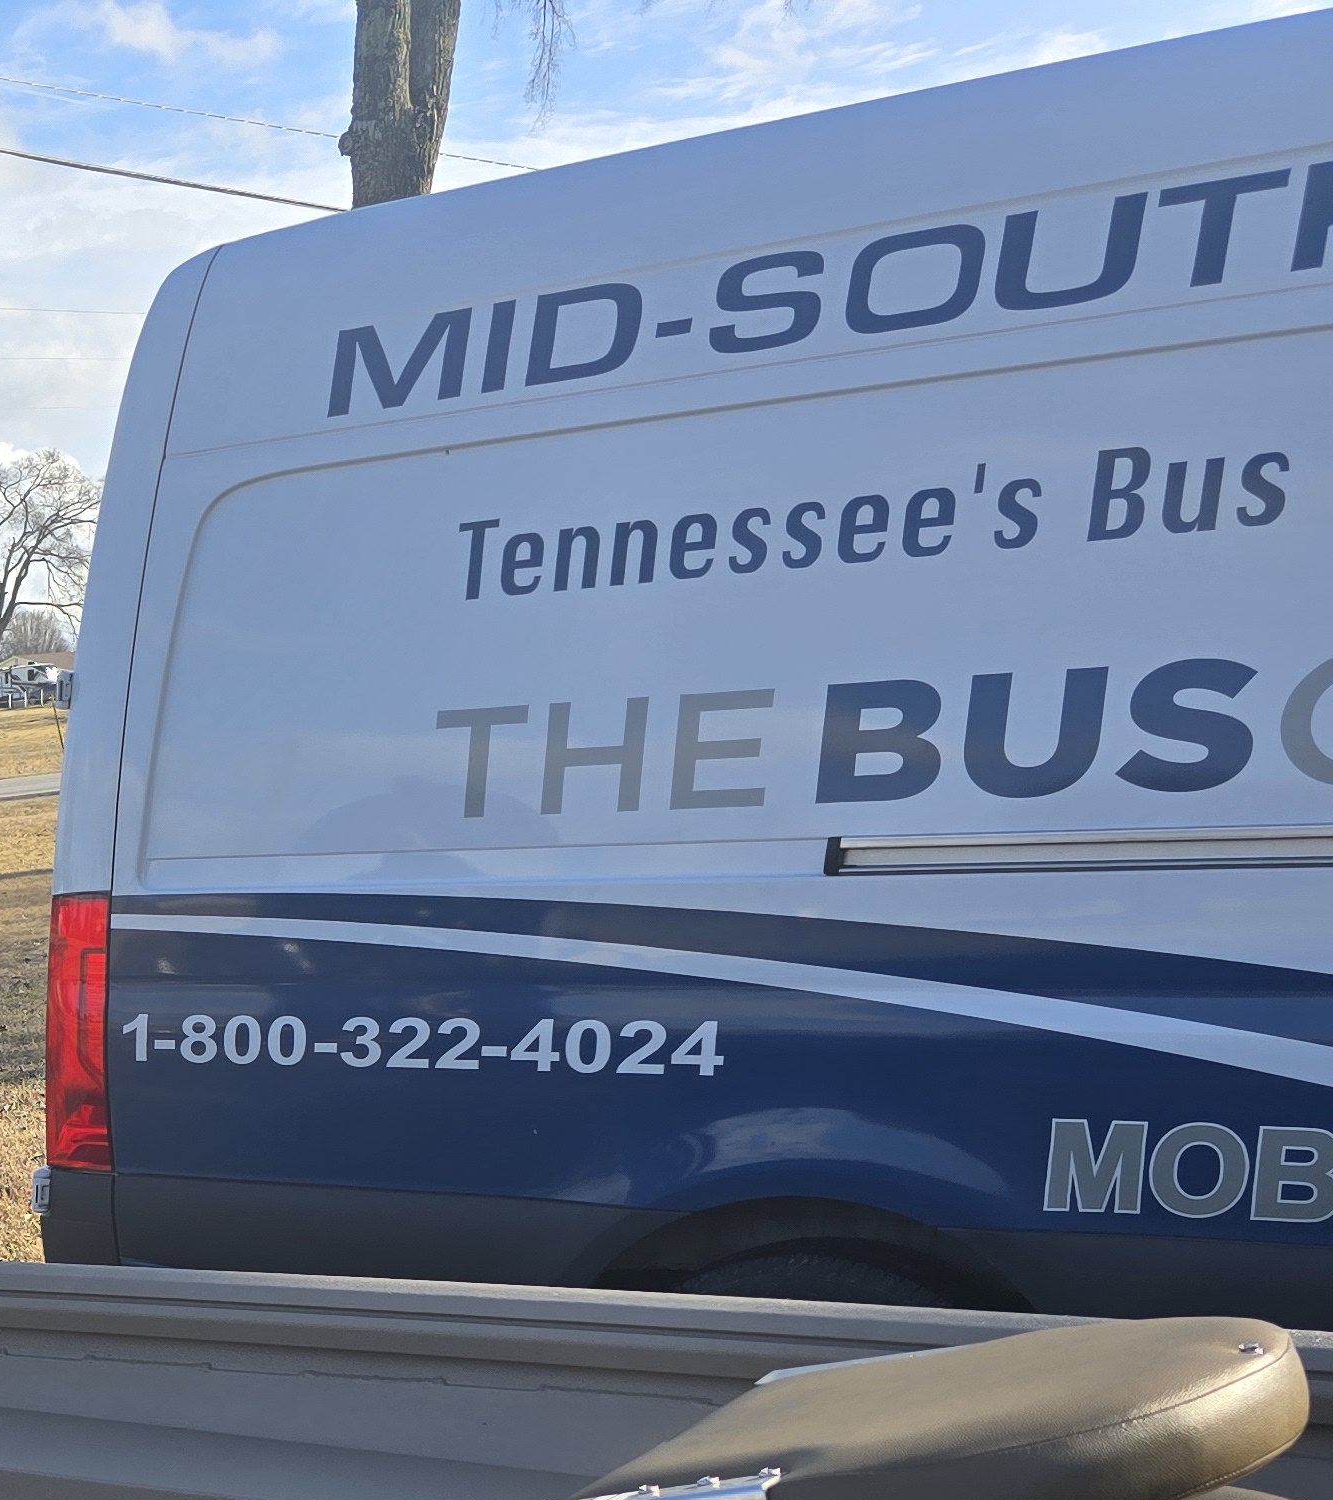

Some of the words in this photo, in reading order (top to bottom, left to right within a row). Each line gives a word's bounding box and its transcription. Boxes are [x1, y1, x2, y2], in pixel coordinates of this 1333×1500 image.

[457, 462, 1042, 601] Tennessee's
[1086, 446, 1291, 543] Bus
[434, 687, 777, 819] THE
[122, 1013, 725, 1076] 1-800-322-4024
[1042, 1117, 1333, 1223] MOB
